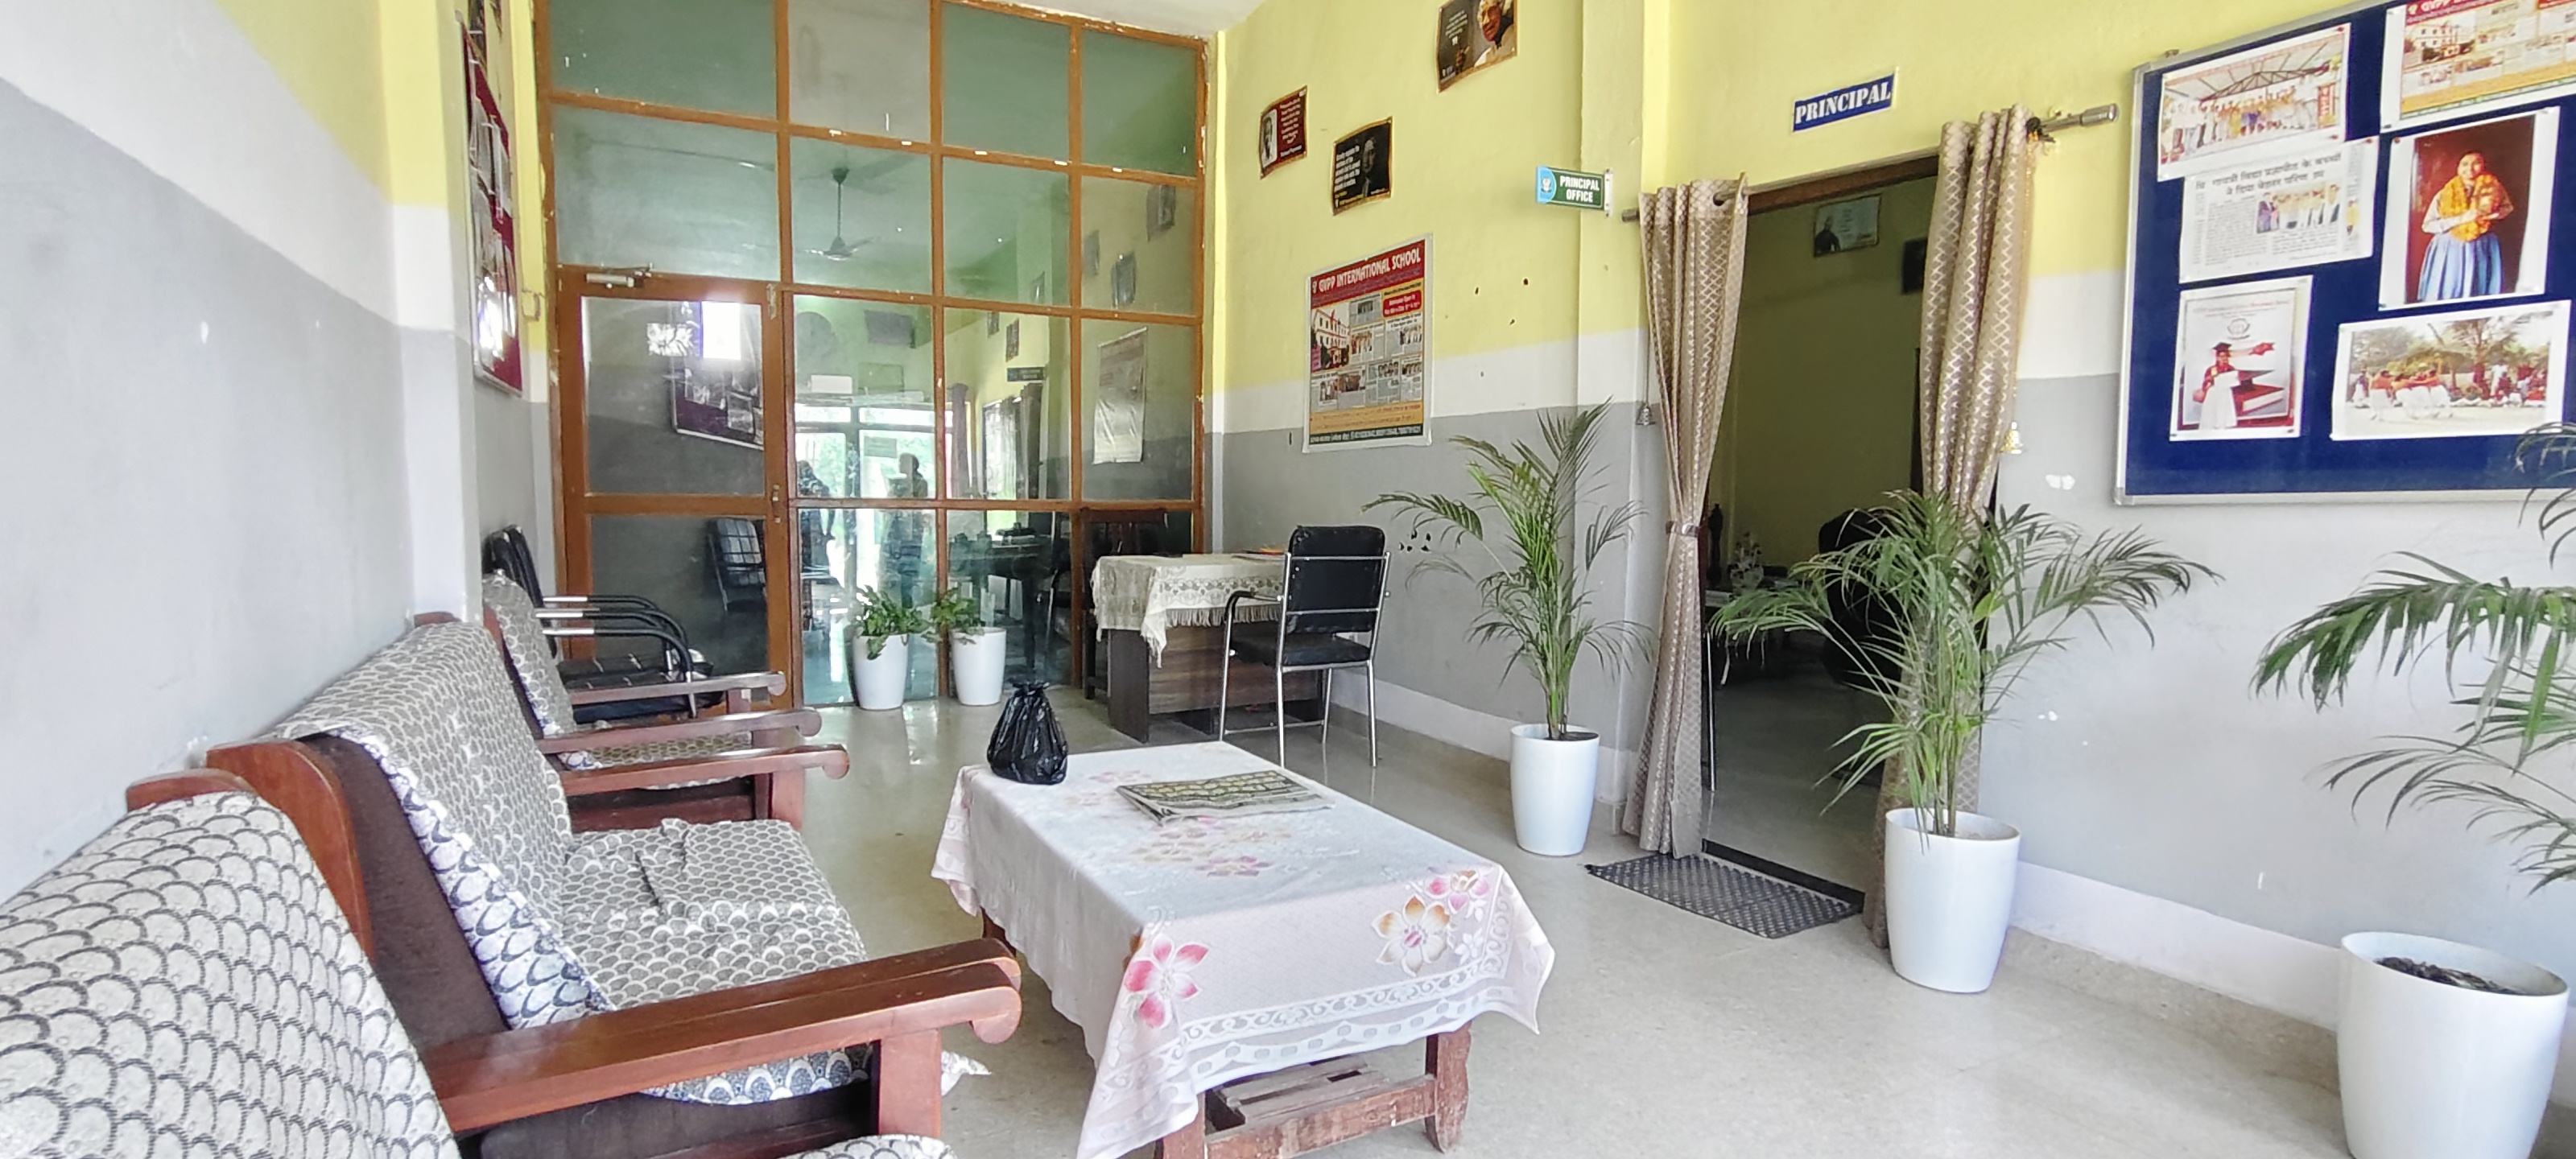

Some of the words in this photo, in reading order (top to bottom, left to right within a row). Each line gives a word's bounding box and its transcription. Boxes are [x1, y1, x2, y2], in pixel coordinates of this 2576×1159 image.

[1795, 81, 1891, 124] PRINCIPAL
[1560, 175, 1600, 191] PRINCIPAL
[1567, 189, 1593, 203] OFFICE
[1337, 258, 1390, 287] INTERNATIONAL
[1392, 247, 1422, 270] SCHOOL
